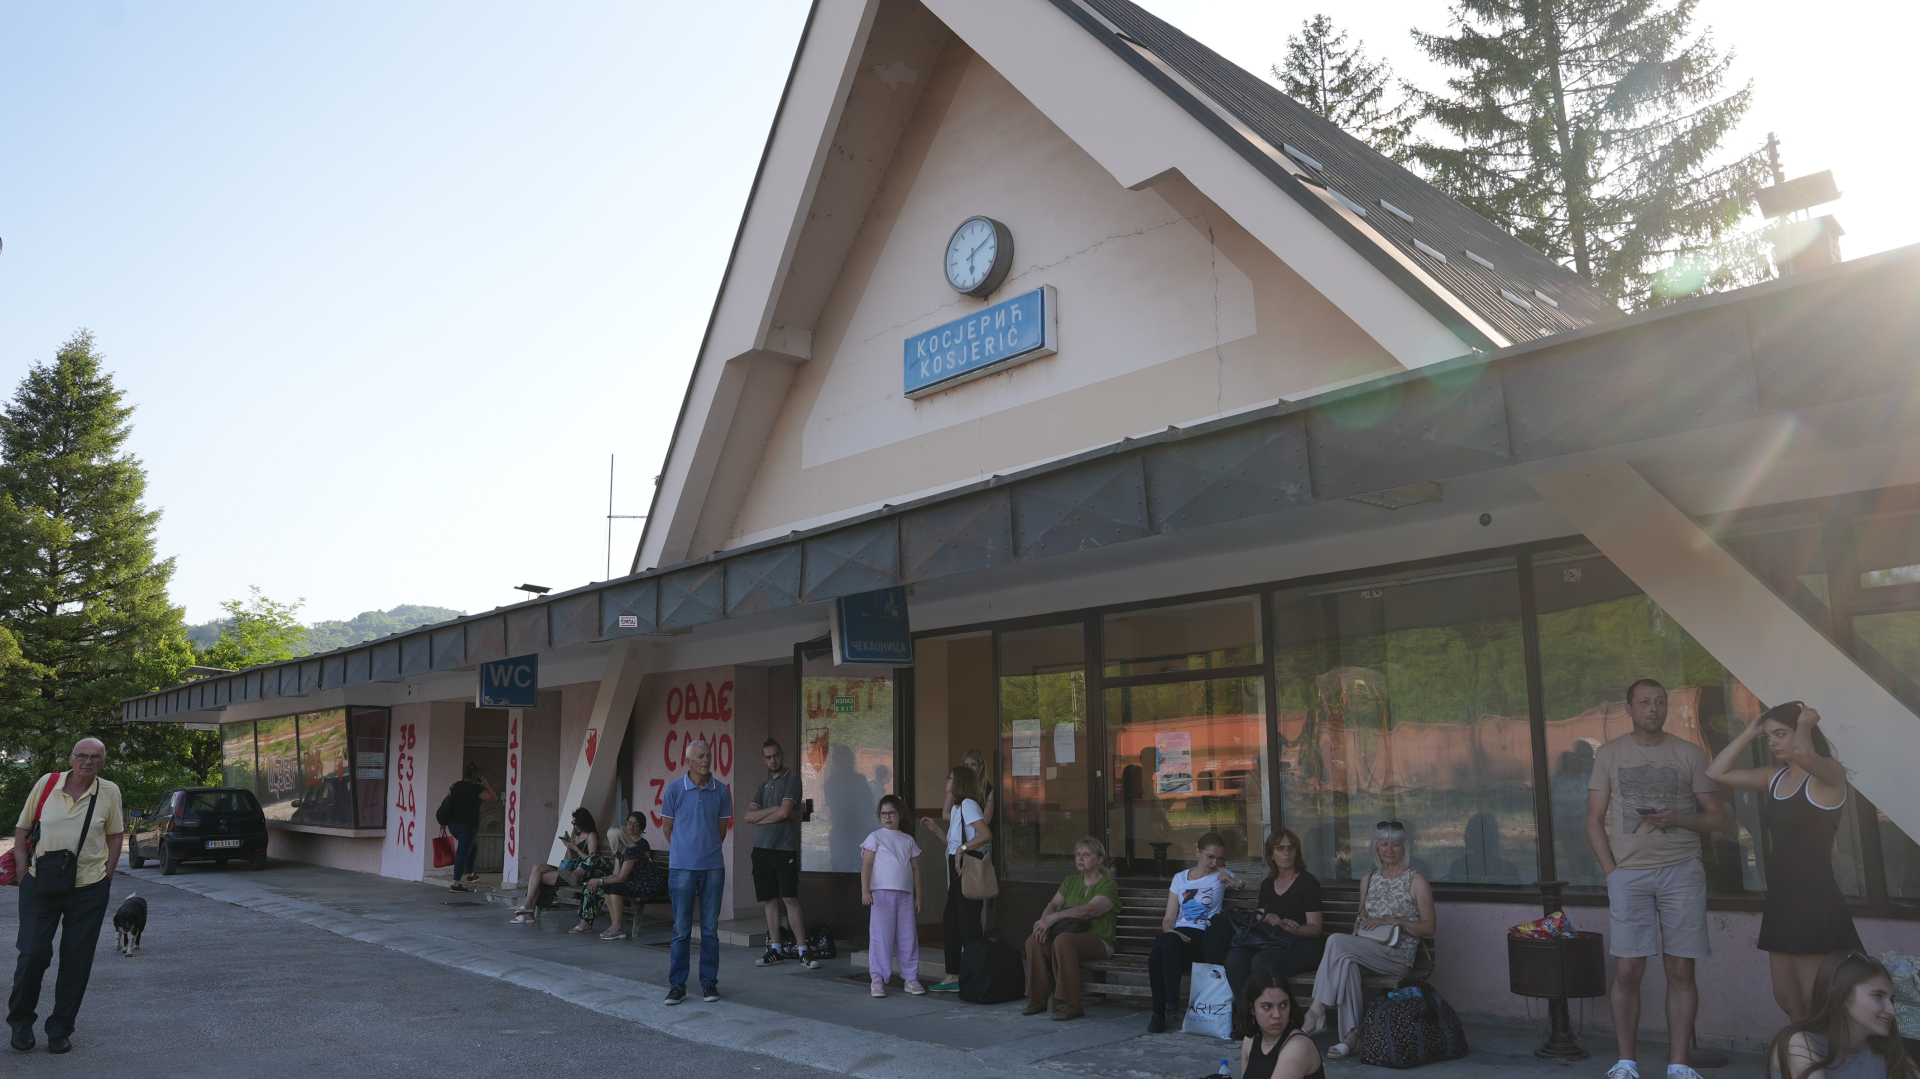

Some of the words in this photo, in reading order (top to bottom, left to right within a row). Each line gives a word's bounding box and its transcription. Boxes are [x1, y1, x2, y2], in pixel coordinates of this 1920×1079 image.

[917, 303, 1022, 358] КОСЈЕРИЋ
[920, 324, 1019, 379] KOSJERIĆ
[851, 641, 907, 653] ЧЕКАОНИЦА
[488, 664, 532, 688] WC
[667, 681, 734, 725] ОВДЕ
